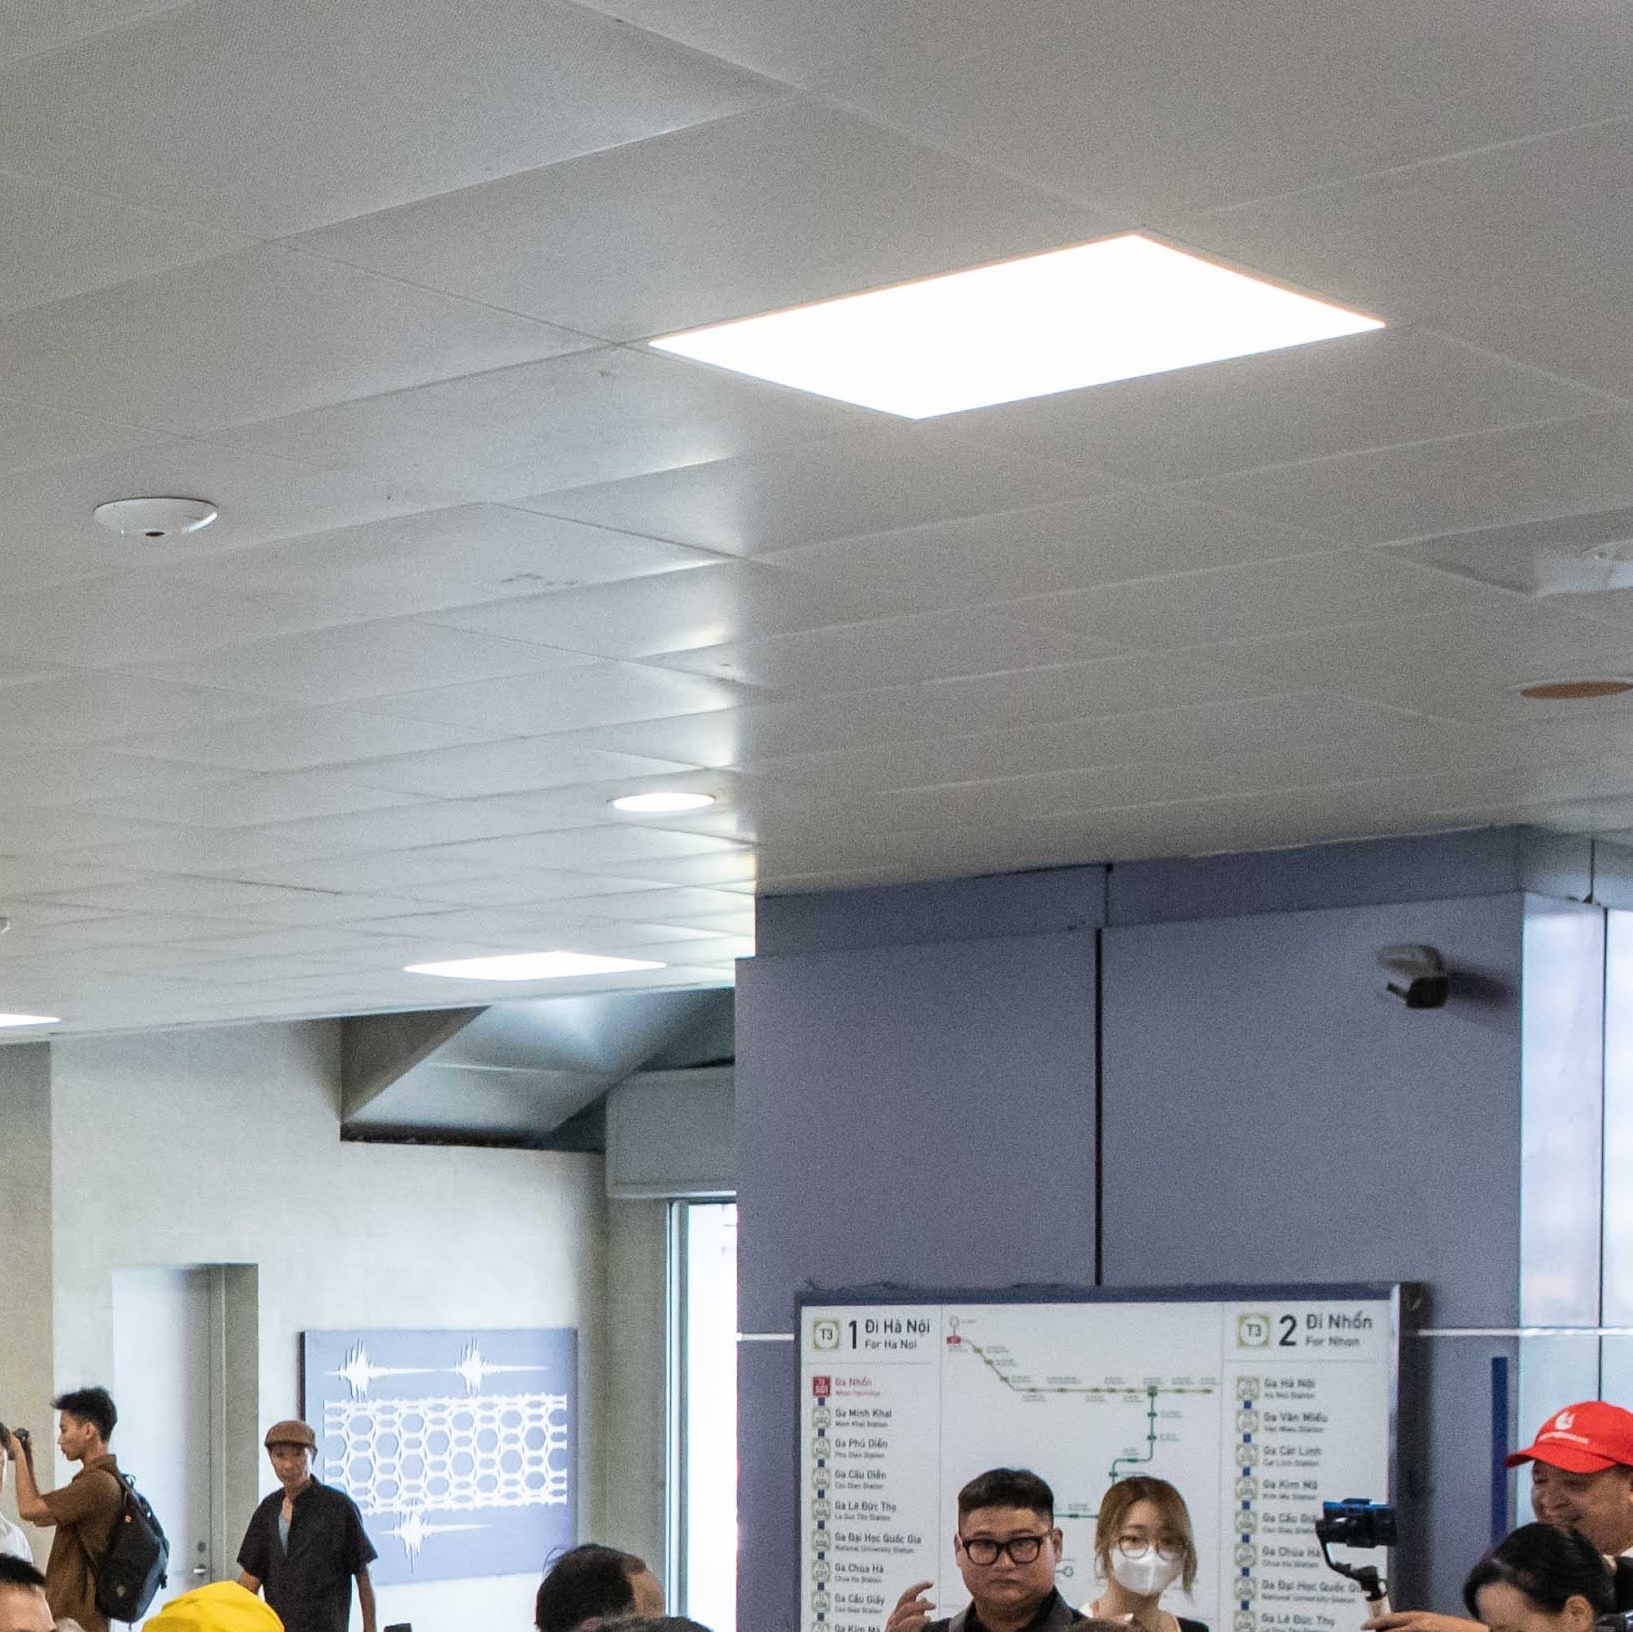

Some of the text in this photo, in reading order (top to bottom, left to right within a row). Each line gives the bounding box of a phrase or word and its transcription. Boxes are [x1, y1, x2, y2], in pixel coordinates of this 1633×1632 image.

[865, 1319, 879, 1334] Đi
[884, 1319, 902, 1334] Hà
[906, 1319, 930, 1337] Nội
[1306, 1313, 1322, 1329] Đi
[820, 1328, 833, 1341] T3
[848, 1320, 857, 1349] 1
[1246, 1323, 1262, 1337] T3
[1279, 1314, 1297, 1346] 2
[865, 1340, 917, 1349] For Ha Noi
[836, 1409, 892, 1418] Ga Minh Khai
